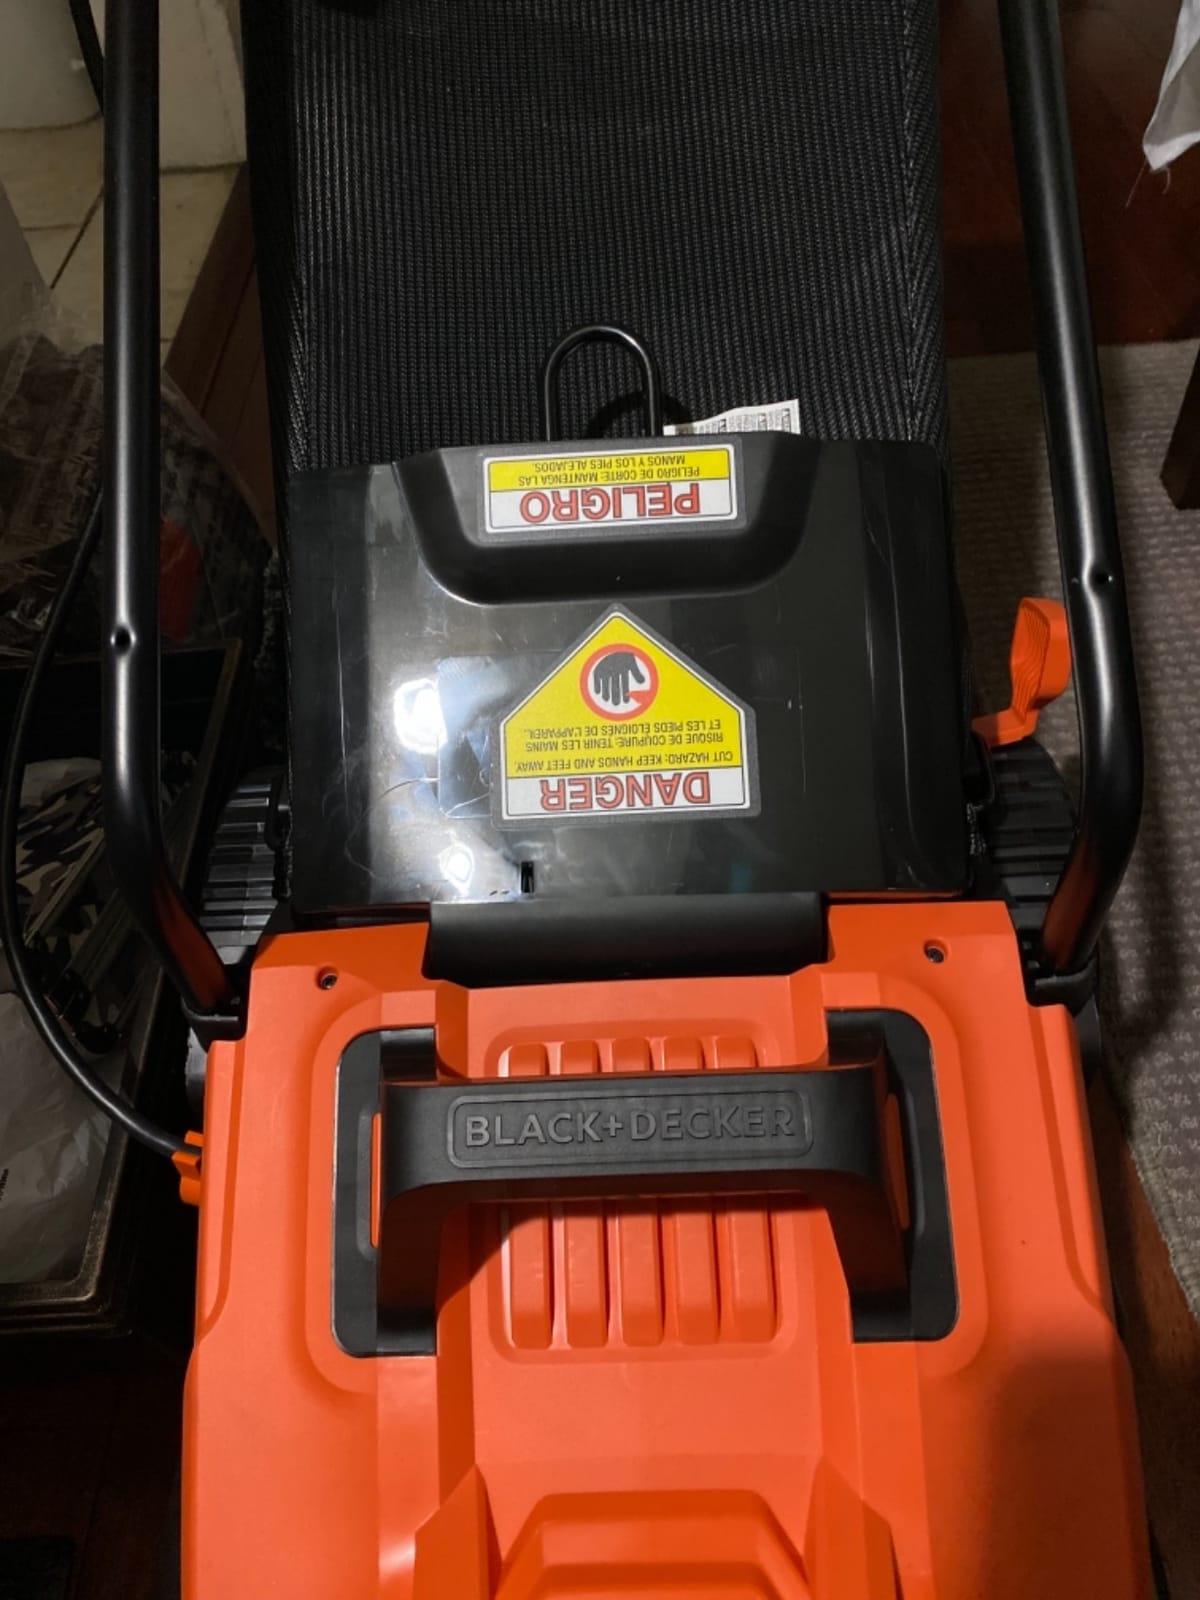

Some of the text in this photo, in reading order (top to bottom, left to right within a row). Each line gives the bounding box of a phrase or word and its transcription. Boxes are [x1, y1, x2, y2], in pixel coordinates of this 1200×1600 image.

[590, 459, 612, 469] PIES
[616, 457, 635, 468] LOS
[639, 457, 644, 466] Y
[648, 455, 685, 466] MANOS
[541, 472, 598, 484] MANTENGA
[640, 469, 653, 479] DE
[657, 467, 699, 478] PELIGRO
[519, 476, 537, 486] LAS
[520, 483, 700, 523] PELIGRO
[654, 722, 683, 733] PIEDS
[687, 721, 705, 732] LES
[709, 719, 720, 730] ET
[584, 726, 598, 737] DE
[584, 738, 613, 748] TENIR
[668, 735, 682, 745] DE
[686, 732, 723, 744] RISQUE
[525, 741, 558, 752] MAINS
[562, 740, 580, 750] LES
[599, 756, 632, 767] HANDS
[637, 755, 661, 765] KEEP
[714, 751, 733, 761] CUT
[546, 760, 571, 770] FEET
[574, 758, 595, 769] AND
[540, 772, 711, 811] DANGER
[465, 1105, 796, 1148] BLACK+DECKER
